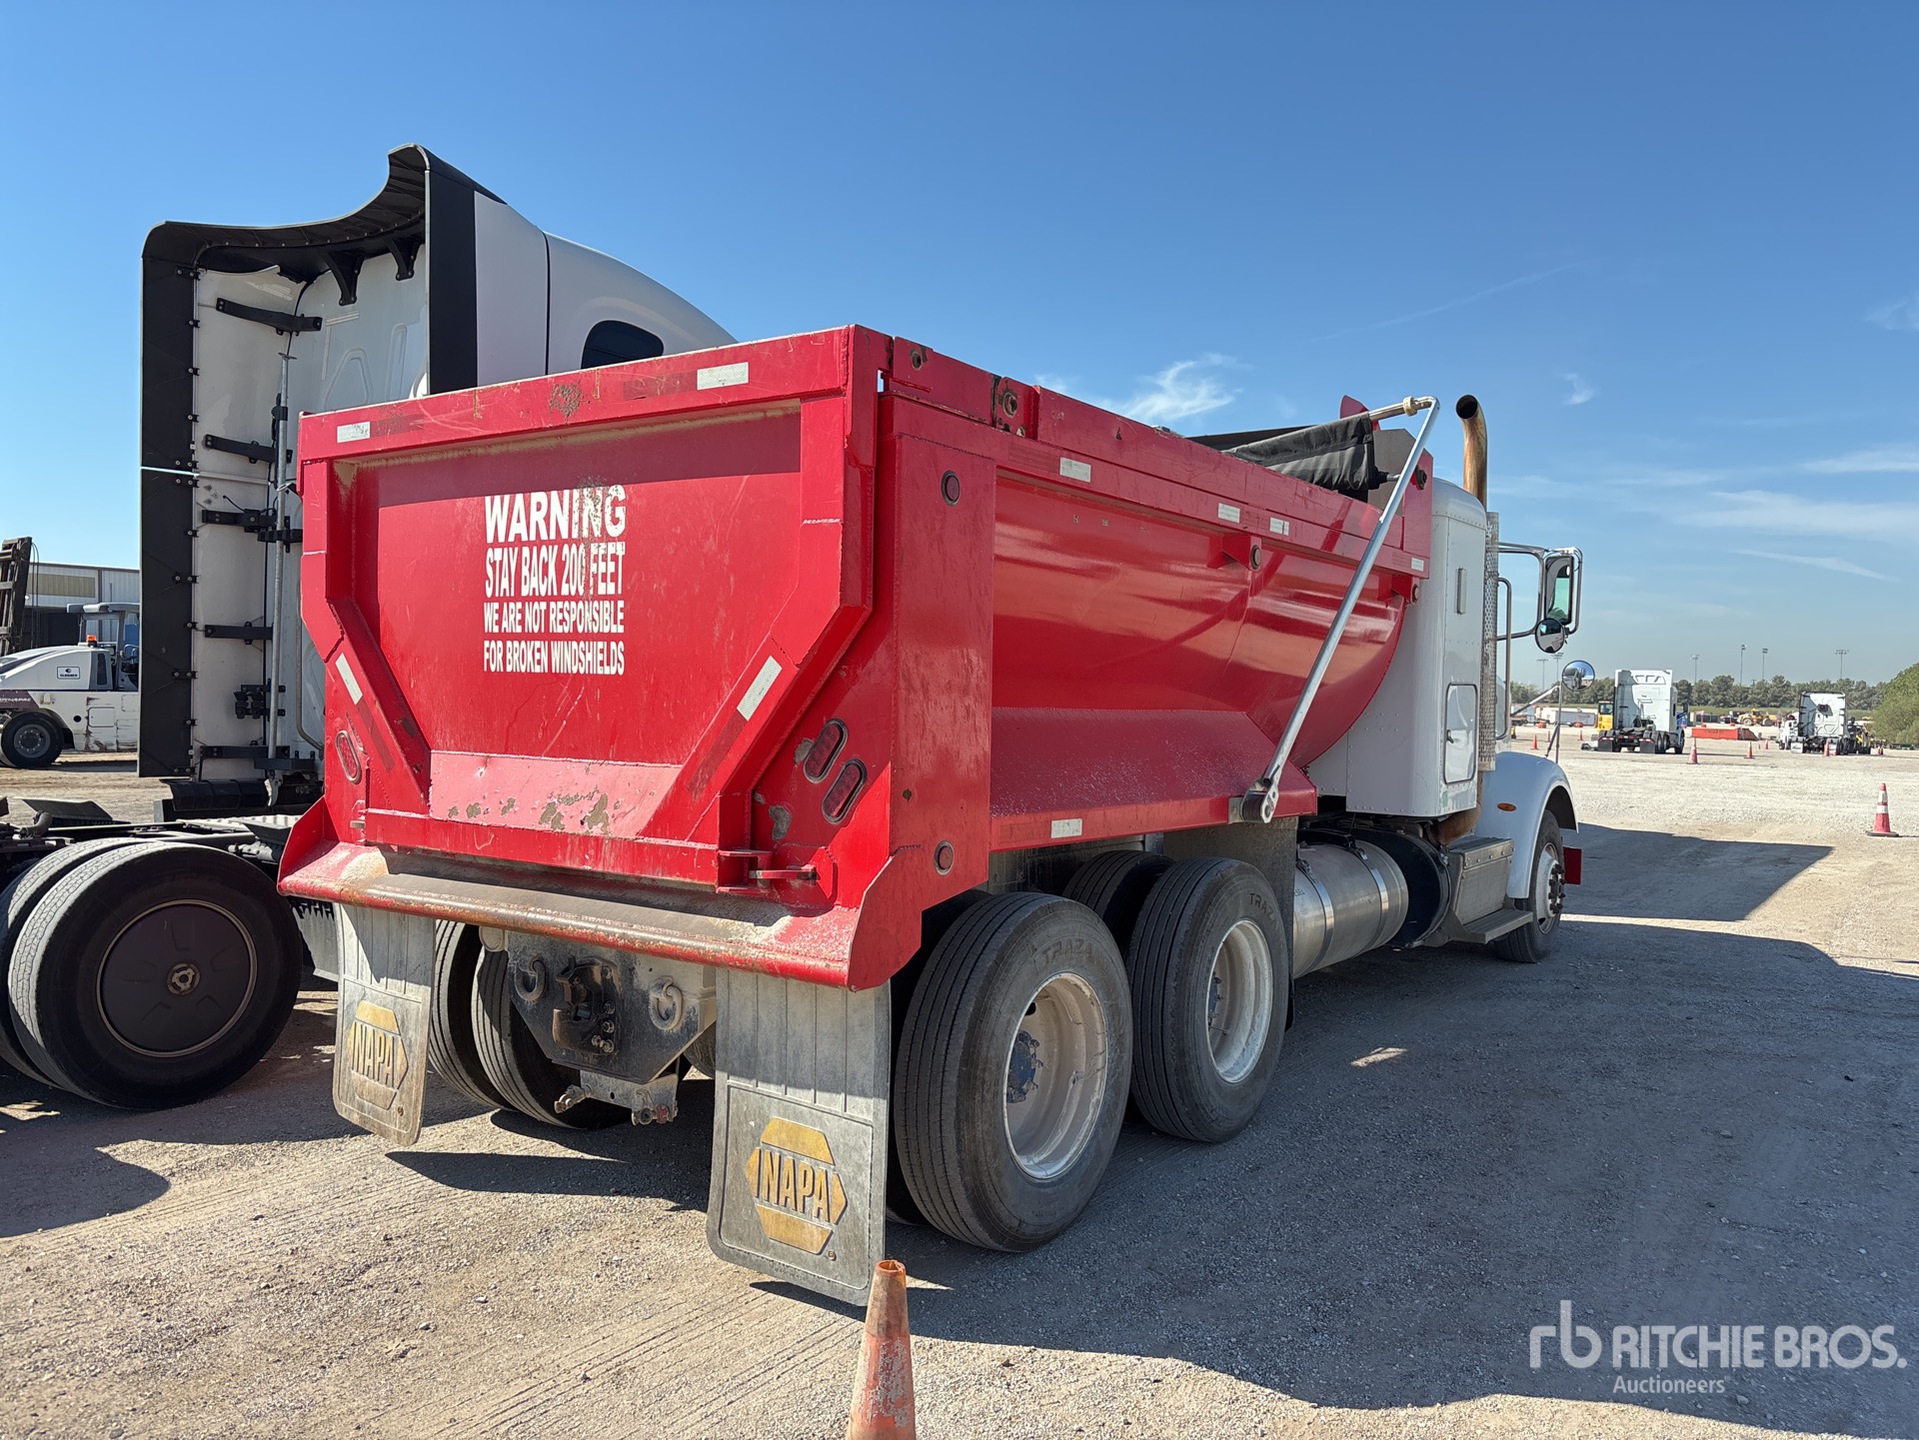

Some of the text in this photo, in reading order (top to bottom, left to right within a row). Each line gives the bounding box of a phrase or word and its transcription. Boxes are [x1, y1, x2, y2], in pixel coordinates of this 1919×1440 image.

[485, 484, 627, 543] WARNING
[485, 541, 626, 598] STAY BACK 200 FEET
[483, 600, 625, 633] WE ARE NOT RESPONSIBLE
[483, 640, 625, 675] FOR BROKEN WINDSHIELDS
[351, 1021, 395, 1089] NAPA
[762, 1149, 830, 1224] NAPA
